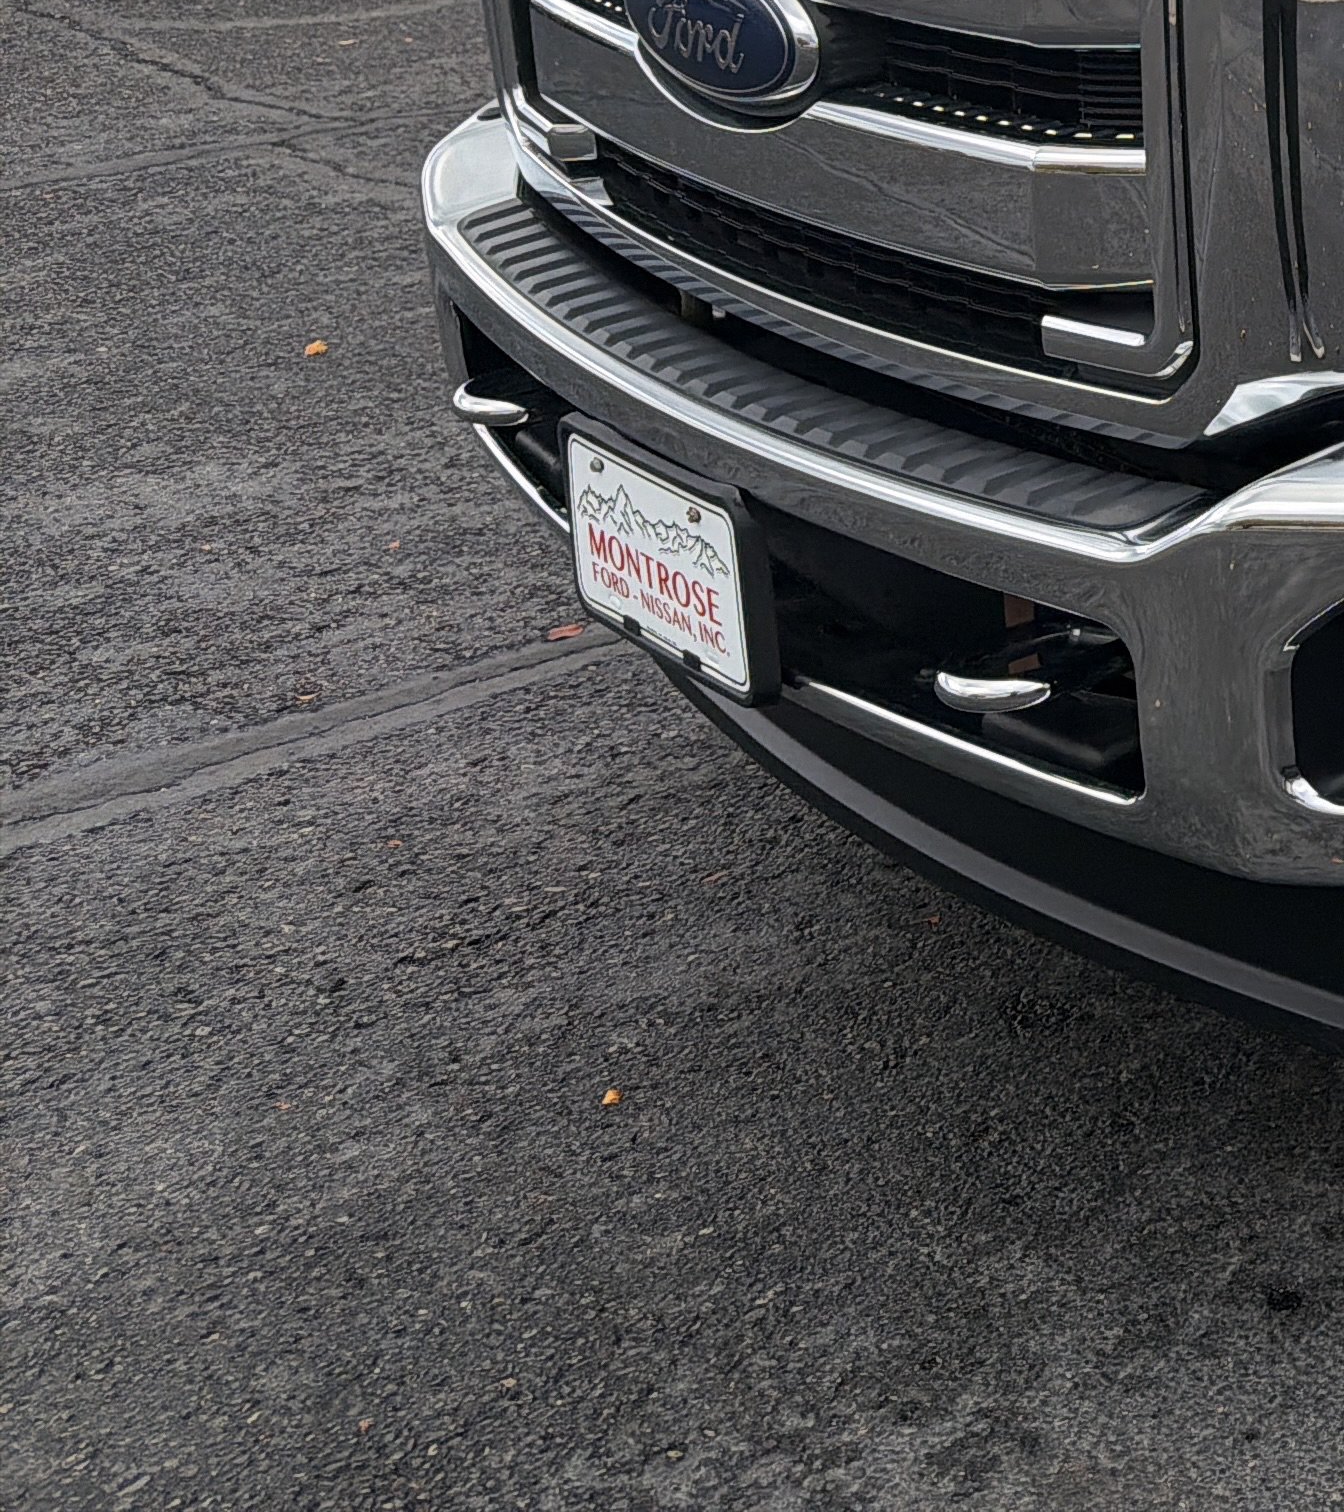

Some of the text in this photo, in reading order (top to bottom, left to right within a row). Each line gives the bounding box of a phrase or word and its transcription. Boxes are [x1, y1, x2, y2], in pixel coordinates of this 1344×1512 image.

[588, 522, 722, 627] MONTROSE
[592, 561, 630, 599] FORD
[641, 588, 698, 643] NISSAN,
[699, 620, 731, 657] INC.
